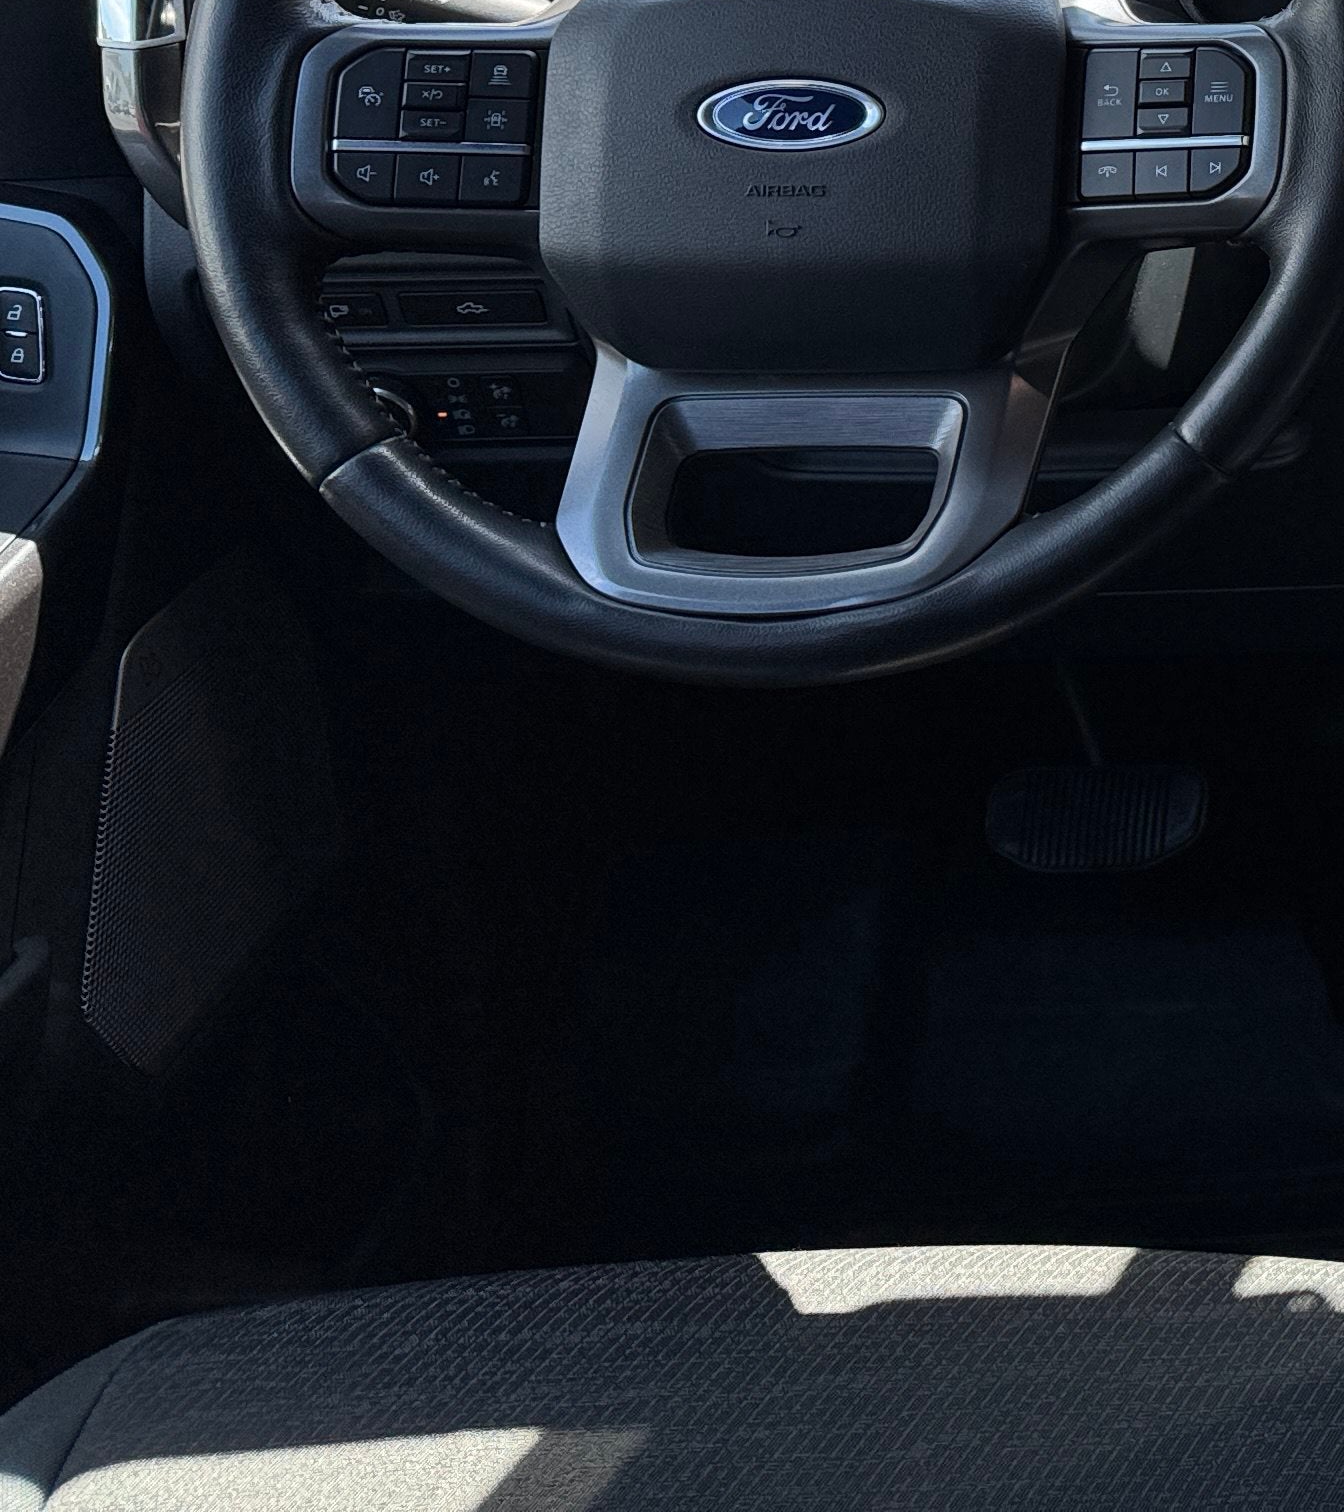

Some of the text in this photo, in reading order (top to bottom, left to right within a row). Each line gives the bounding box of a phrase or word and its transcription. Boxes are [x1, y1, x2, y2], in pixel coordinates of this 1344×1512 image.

[1155, 87, 1170, 96] OK
[1097, 98, 1122, 107] BACK
[1204, 94, 1234, 103] MENU
[742, 92, 837, 131] Ford
[743, 184, 826, 198] AIRBAG
